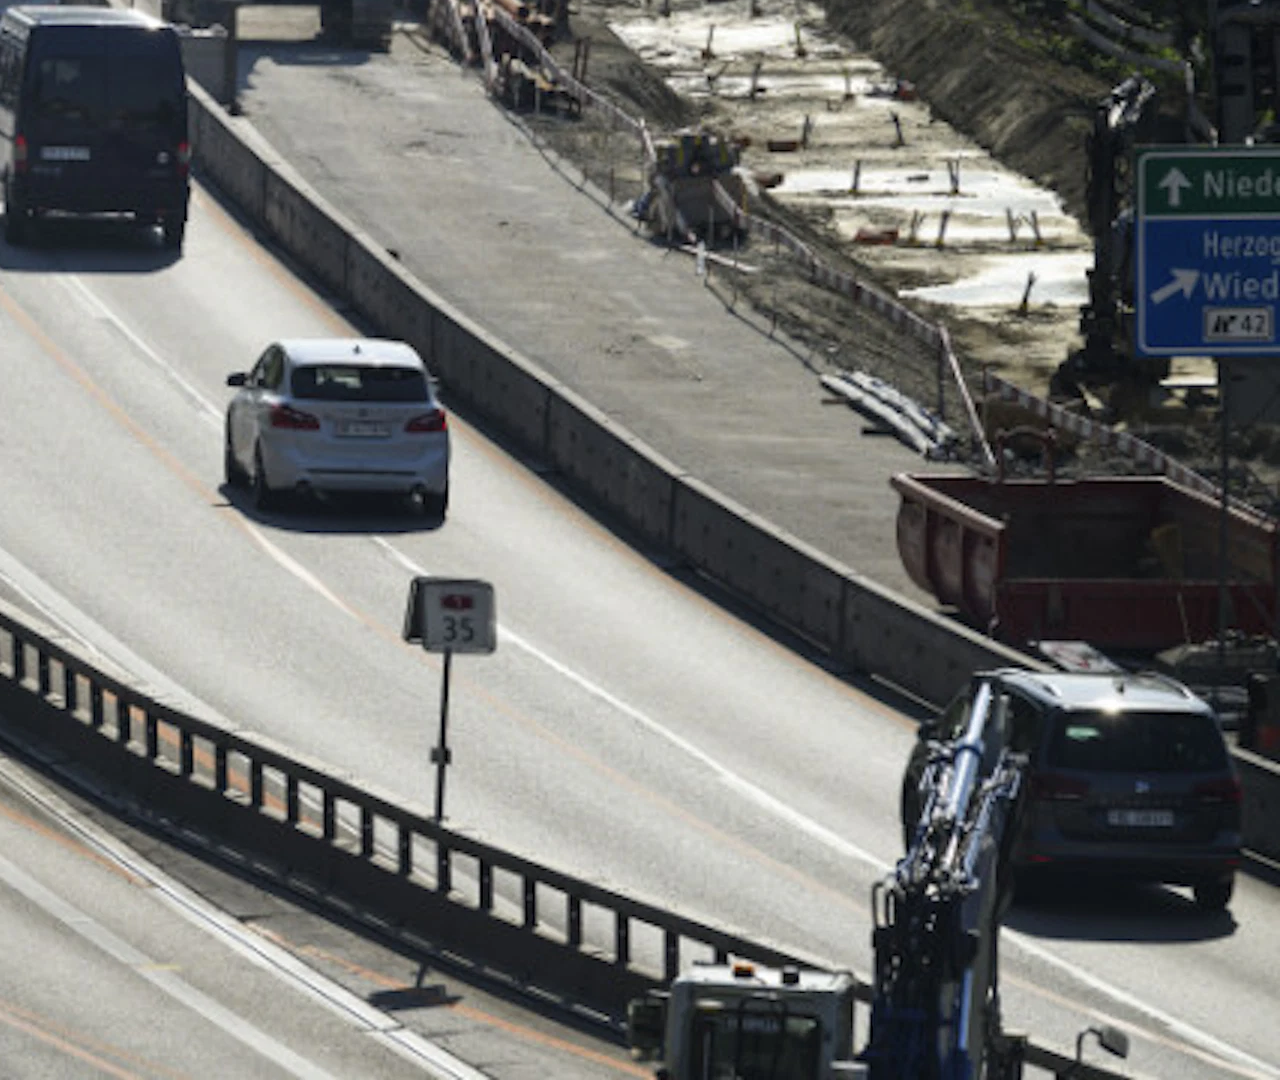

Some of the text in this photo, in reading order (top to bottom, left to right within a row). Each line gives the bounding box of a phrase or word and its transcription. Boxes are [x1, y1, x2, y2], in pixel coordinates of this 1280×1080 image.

[1203, 229, 1280, 266] Herzog
[1203, 269, 1280, 300] Wied
[442, 615, 475, 642] 35
